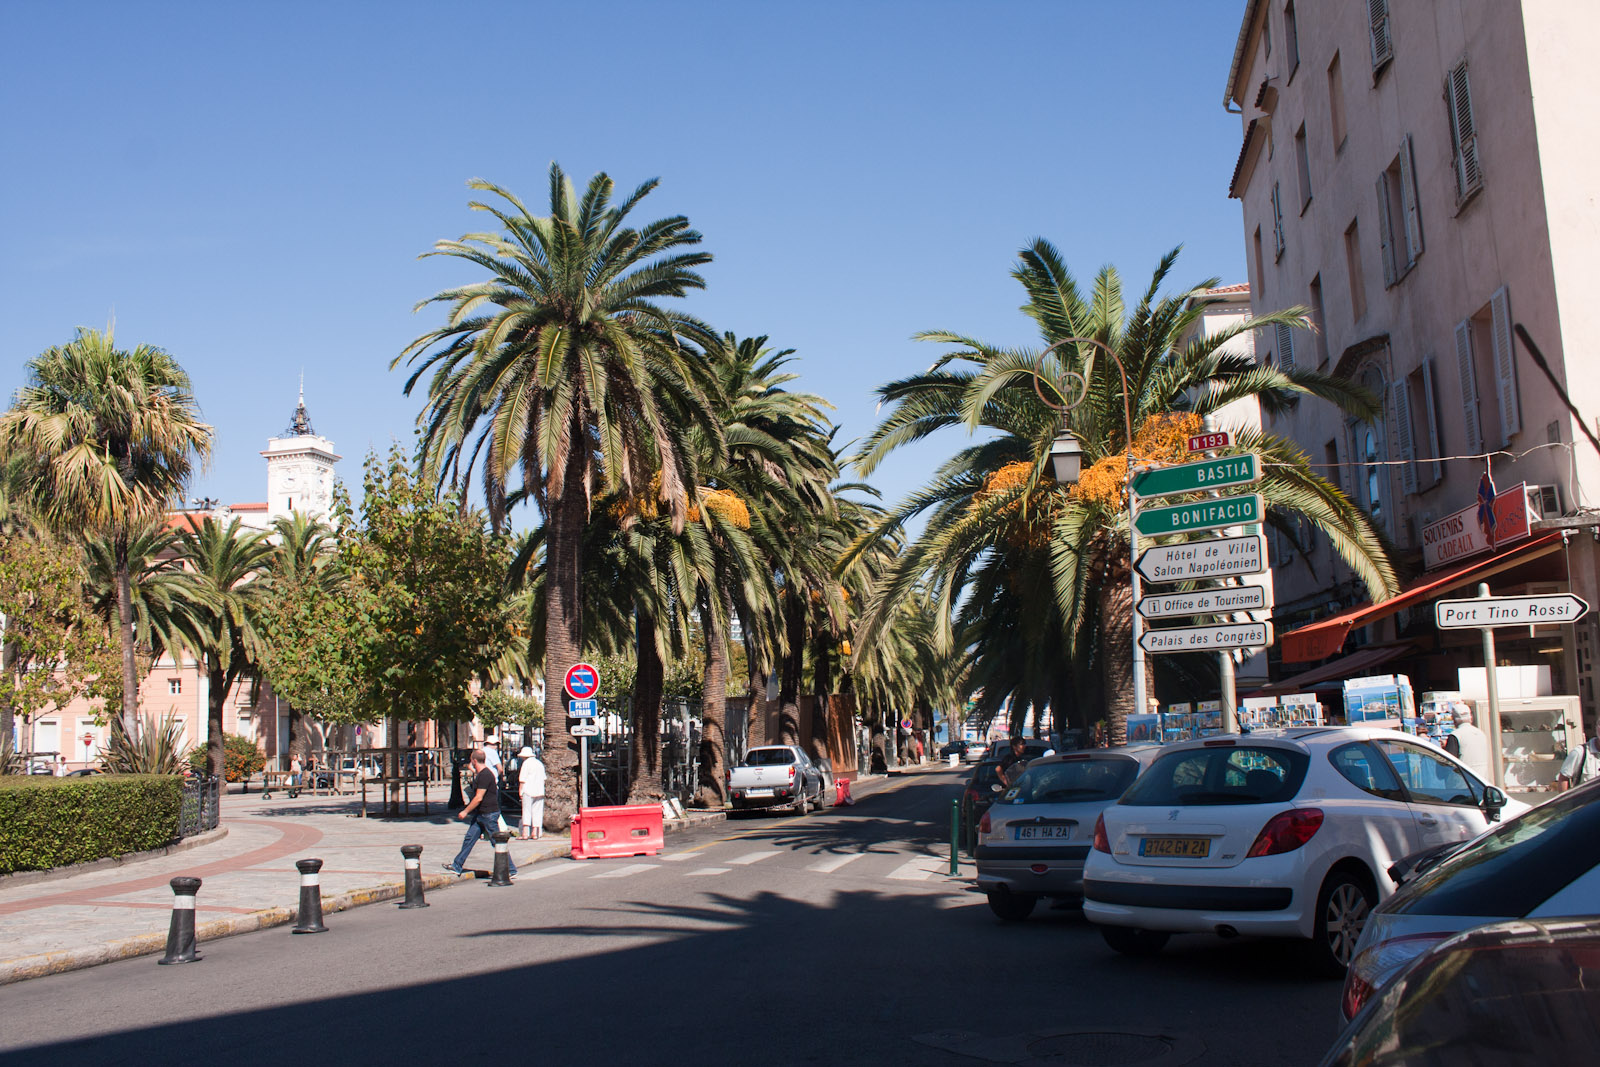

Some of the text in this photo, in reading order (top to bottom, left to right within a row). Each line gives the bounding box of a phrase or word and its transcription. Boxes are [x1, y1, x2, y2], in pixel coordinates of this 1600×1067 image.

[1192, 434, 1224, 449] N 193
[1197, 462, 1249, 482] BASTIA
[1172, 503, 1252, 526] BONIFACIO
[1423, 514, 1464, 546] SOUVENIRS
[1166, 542, 1256, 561] Hôtel de Ville
[1437, 532, 1474, 561] CADEAUX
[1153, 557, 1257, 577] Salon Napoléonien
[1164, 599, 1194, 611] Office
[1197, 597, 1209, 608] de
[1214, 594, 1260, 607] Tourisme
[1445, 602, 1569, 621] Port Tino Rossi
[1151, 629, 1262, 647] Palais des Congrès
[1021, 827, 1067, 838] 461 HA 2A
[1145, 840, 1173, 854] 3742
[1191, 841, 1206, 854] 2A
